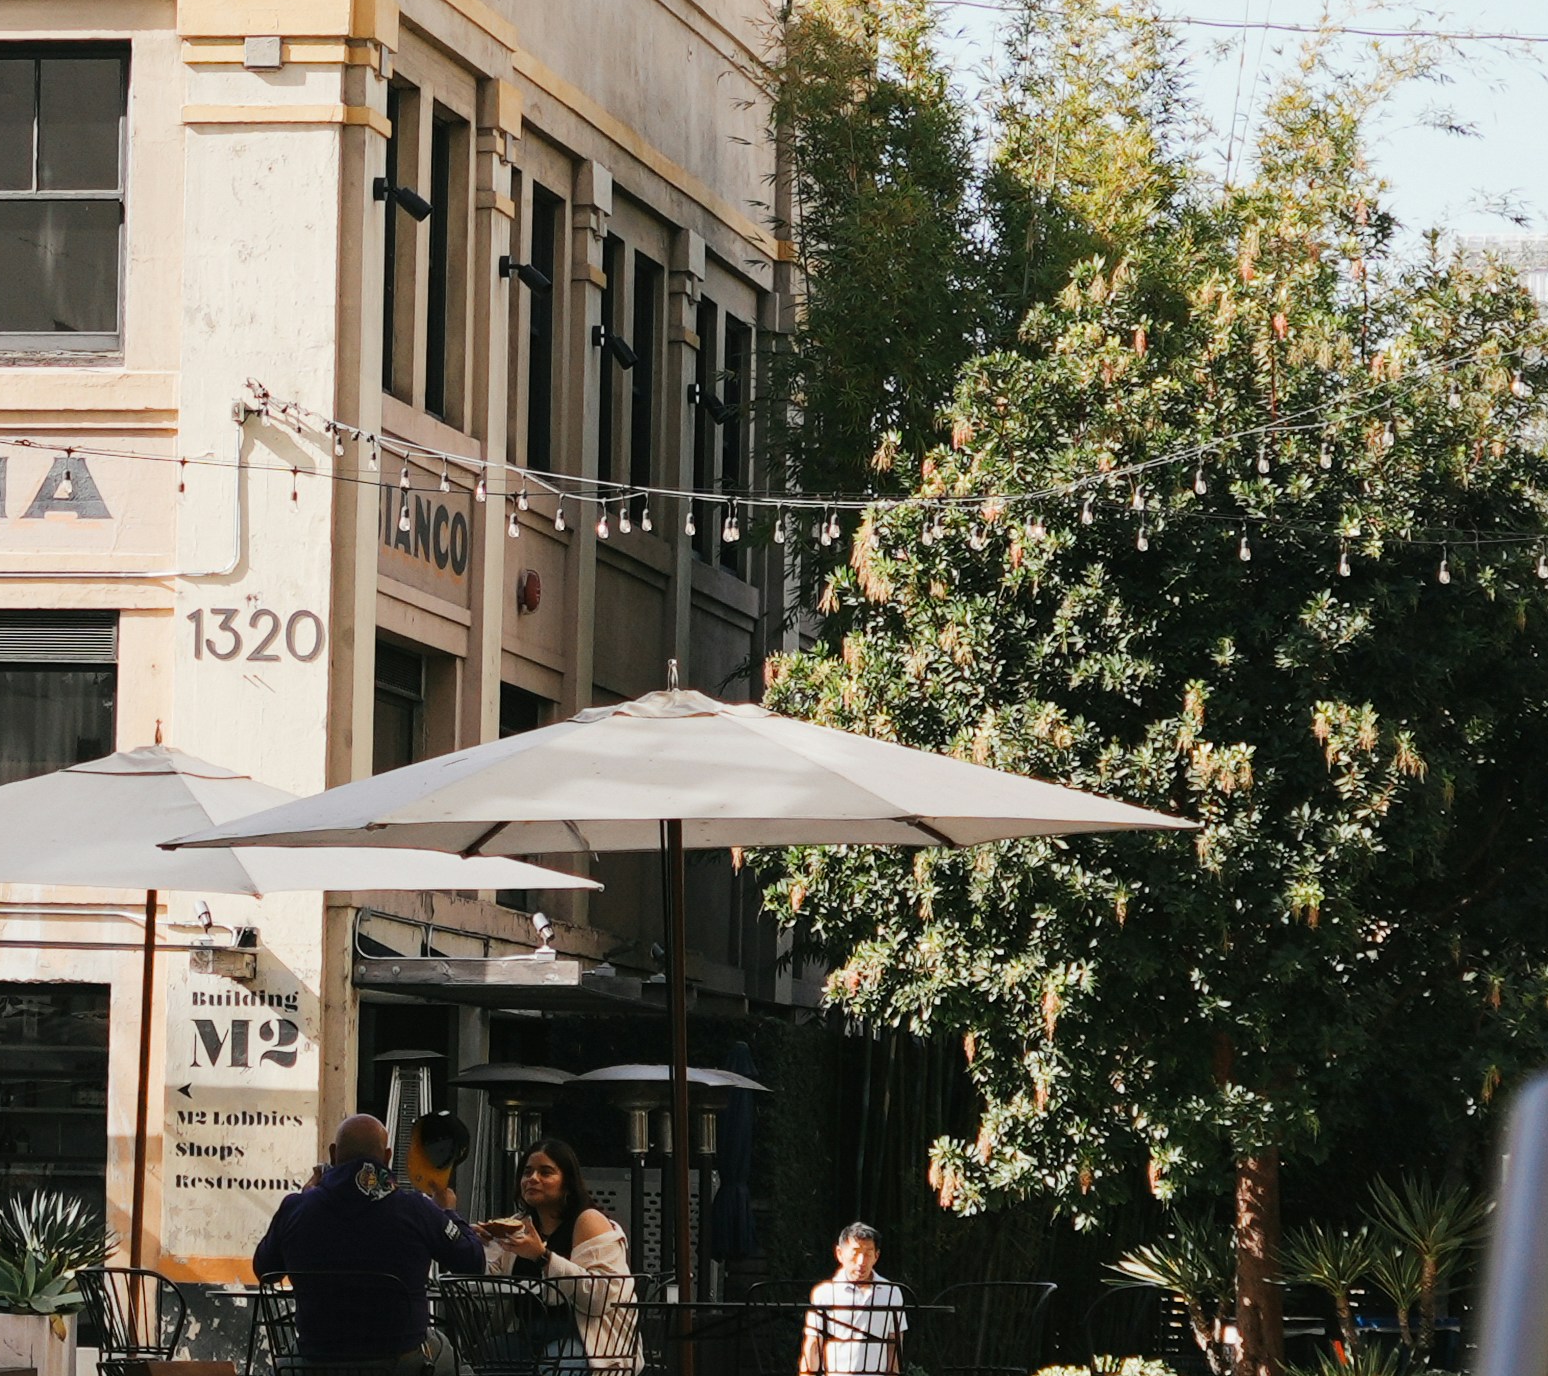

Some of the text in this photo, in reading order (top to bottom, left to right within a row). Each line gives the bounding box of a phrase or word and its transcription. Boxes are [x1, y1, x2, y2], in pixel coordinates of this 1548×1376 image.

[378, 484, 468, 577] IANCO
[186, 607, 327, 663] 1320
[191, 989, 300, 1013] Building
[189, 1018, 300, 1069] M2
[176, 1110, 304, 1128] M2 Lobbies
[175, 1141, 246, 1162] Shops
[175, 1174, 304, 1192] Restrooms
